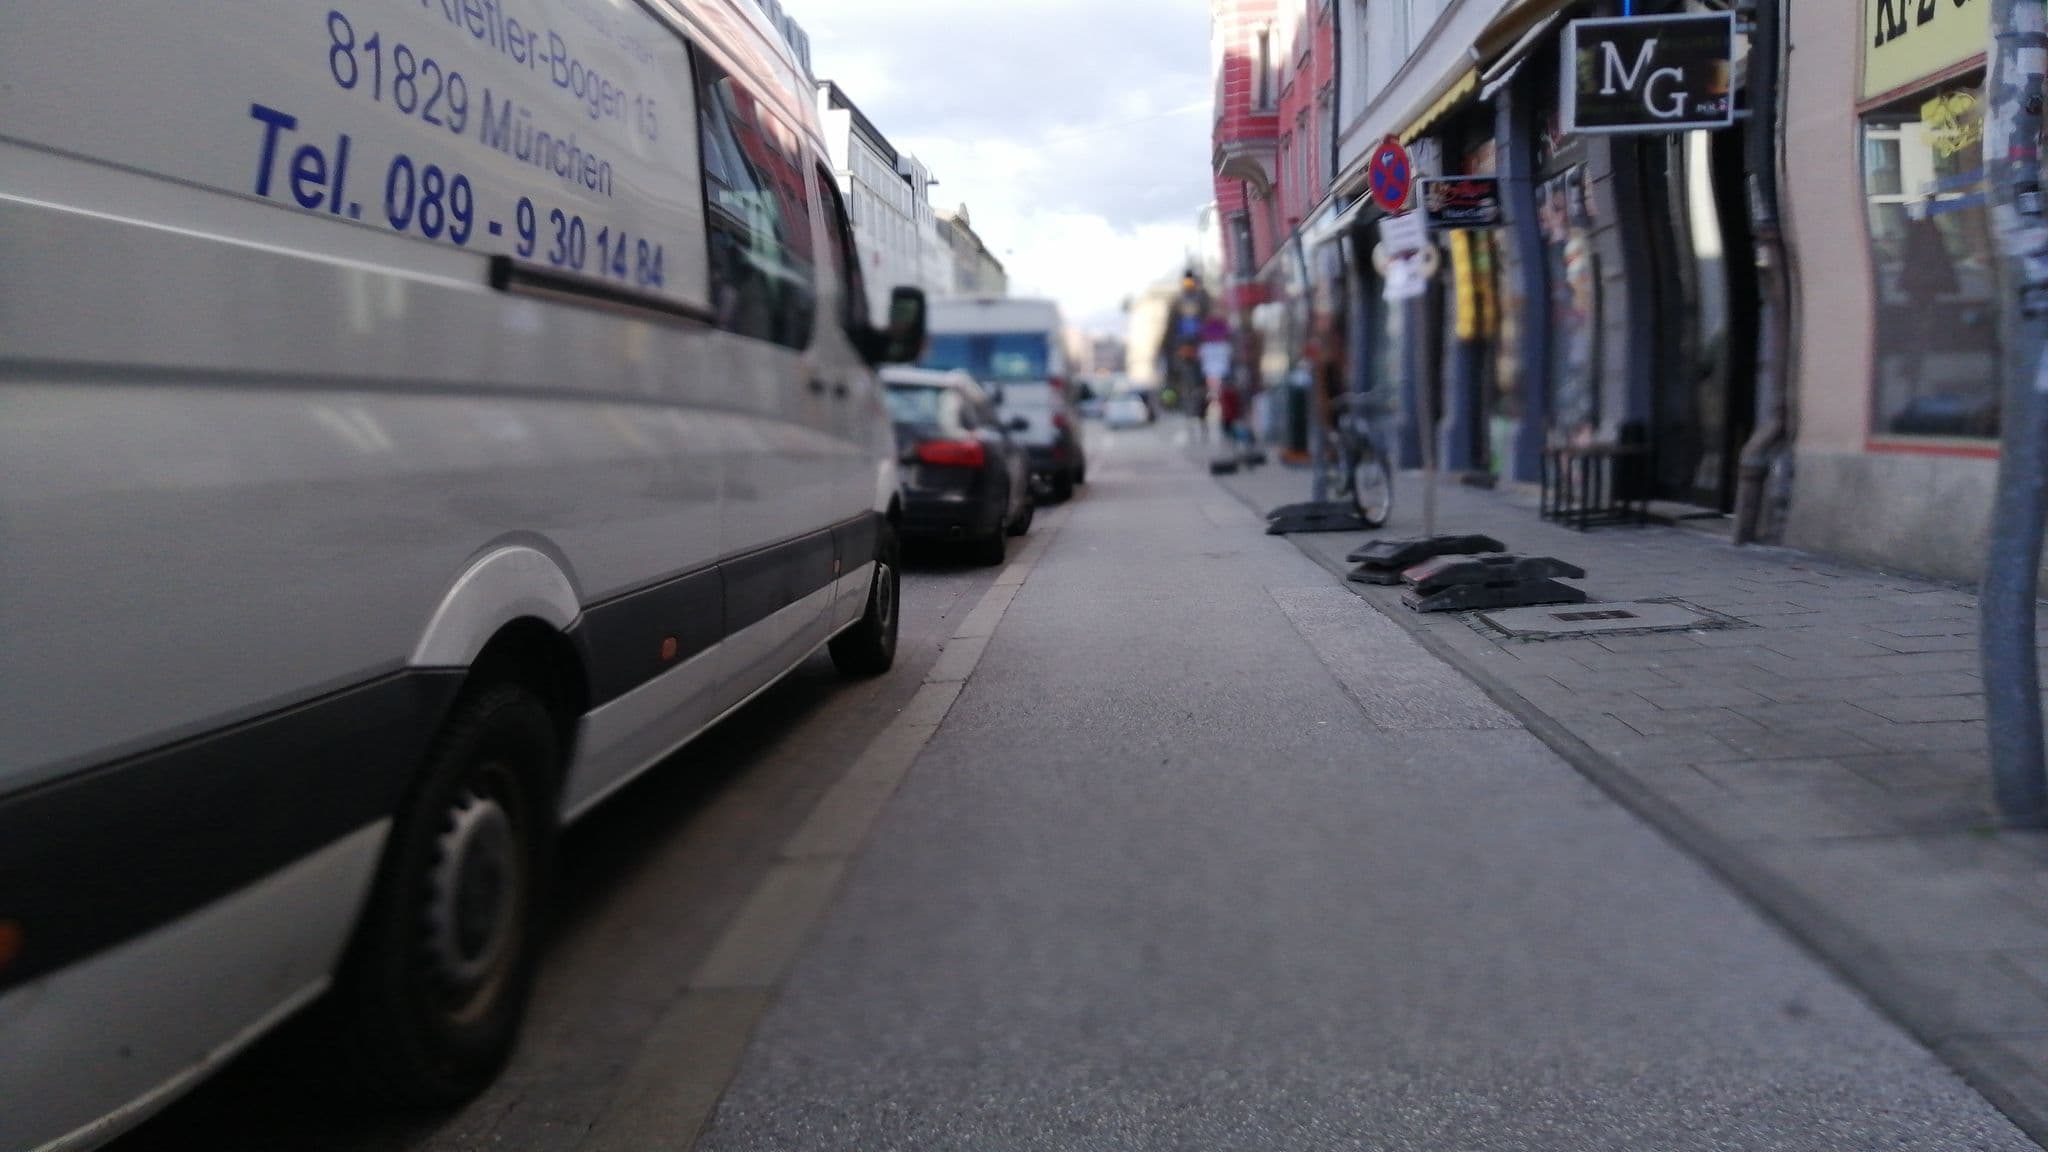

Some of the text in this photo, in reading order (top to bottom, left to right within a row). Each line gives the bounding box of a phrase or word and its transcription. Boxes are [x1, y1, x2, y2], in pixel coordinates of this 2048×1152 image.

[250, 103, 361, 220] Tel.
[385, 153, 473, 246] 089
[516, 196, 536, 258] 9
[549, 207, 587, 271] 30
[597, 225, 627, 279] 14
[637, 238, 664, 288] 84
[327, 9, 468, 134] 81829
[480, 88, 612, 198] München
[635, 93, 657, 142] 15
